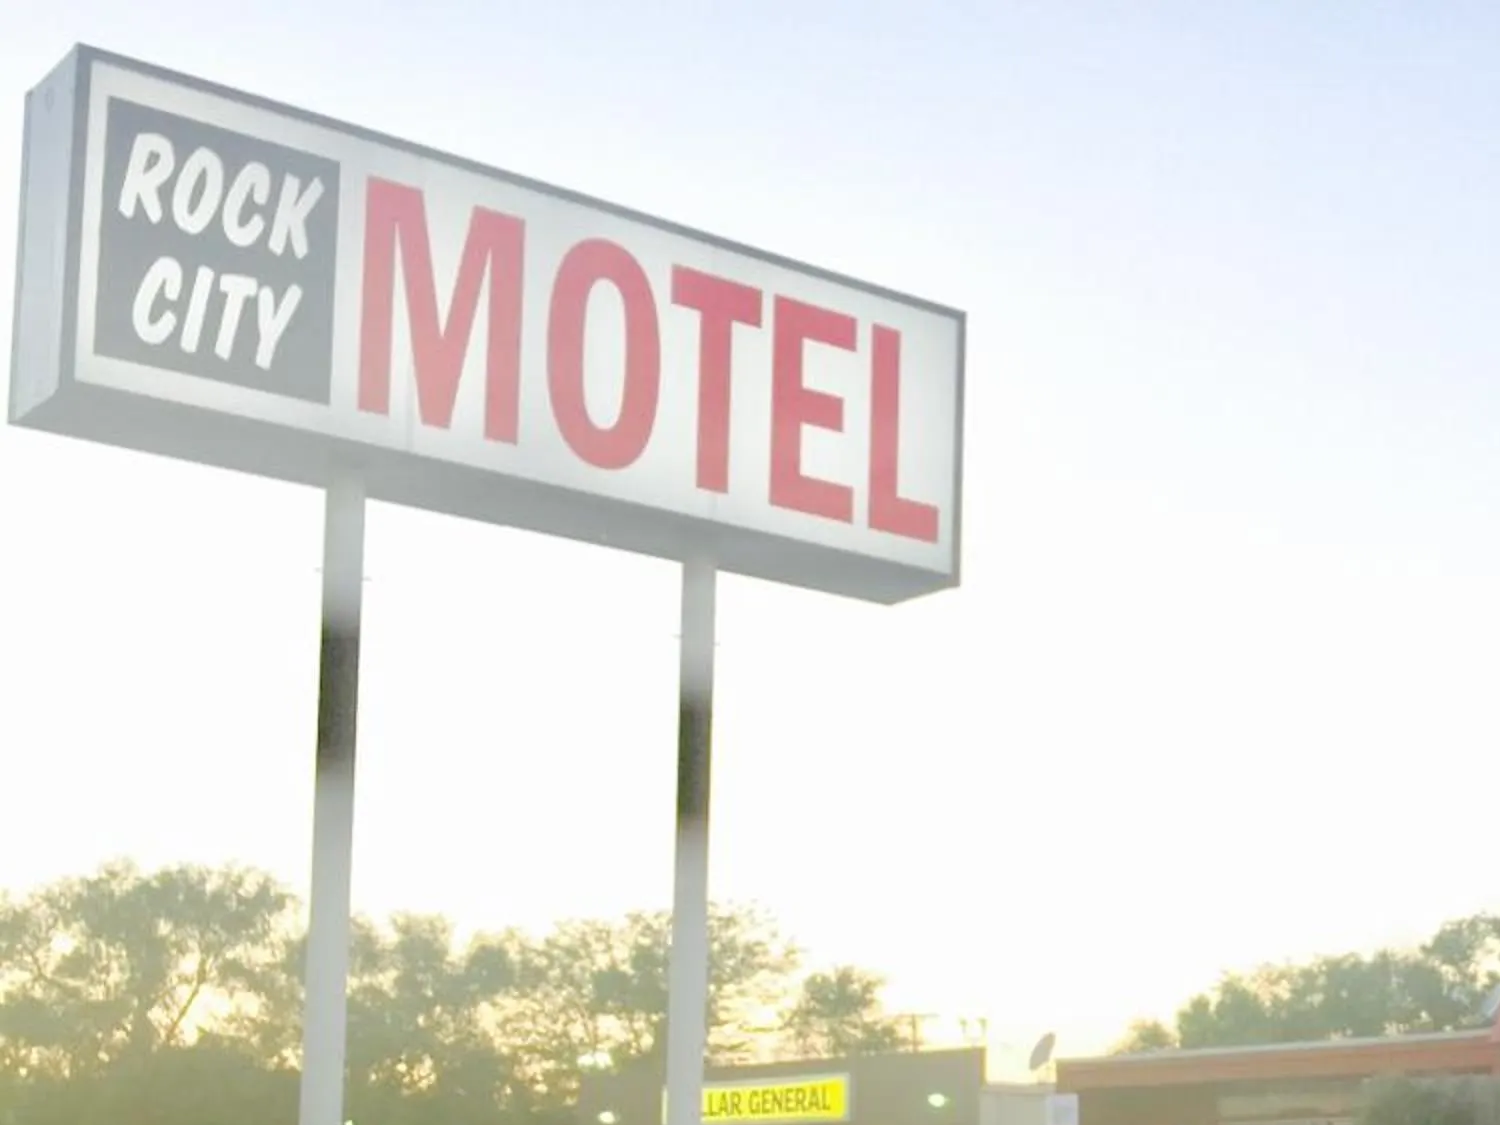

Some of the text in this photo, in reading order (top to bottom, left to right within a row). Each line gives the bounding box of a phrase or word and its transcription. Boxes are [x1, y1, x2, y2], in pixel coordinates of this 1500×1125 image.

[118, 131, 325, 261] ROCK
[132, 257, 303, 371] CITY
[358, 175, 939, 545] MOTEL
[748, 1085, 832, 1115] GENERAL
